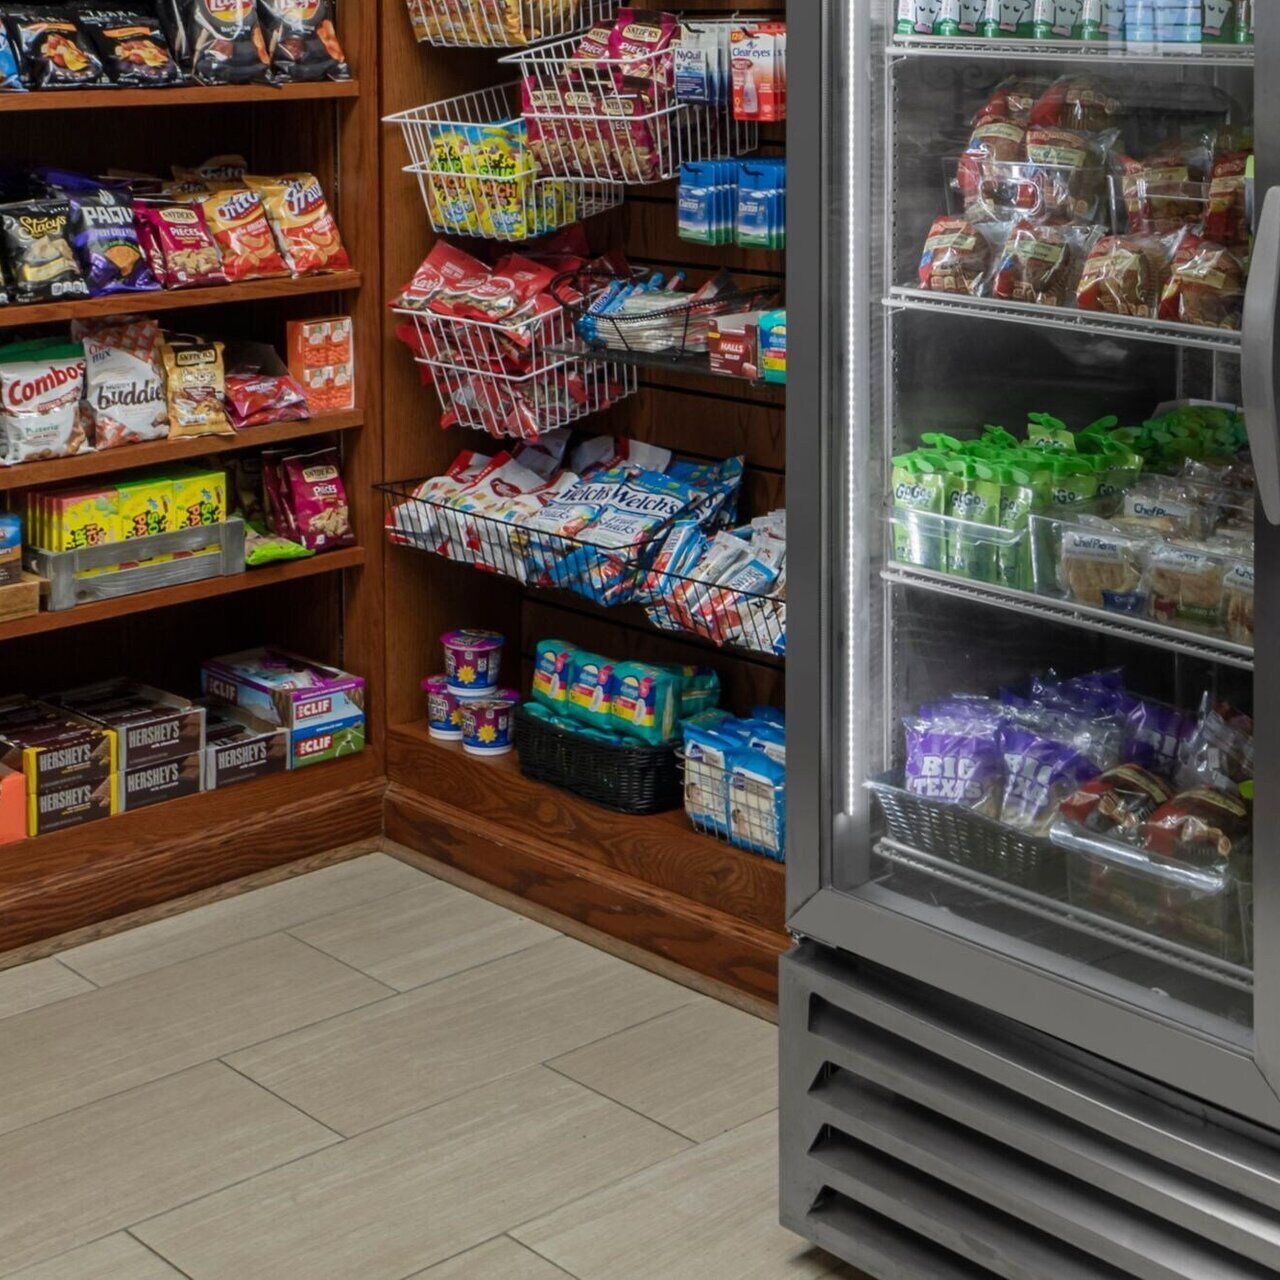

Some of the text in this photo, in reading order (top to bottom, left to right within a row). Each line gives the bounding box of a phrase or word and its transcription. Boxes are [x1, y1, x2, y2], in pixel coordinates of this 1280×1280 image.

[676, 50, 701, 60] NyQuil
[733, 48, 770, 58] Clear eyes
[721, 343, 744, 354] HALLS
[9, 362, 85, 406] Combos
[613, 488, 679, 515] Welch's
[302, 700, 330, 717] CLIF
[128, 720, 180, 749] HERSHEY'S
[305, 736, 332, 753] CLIF
[38, 744, 92, 772] HERSHEY'S
[218, 741, 267, 770] HERSHEY'S
[921, 757, 975, 778] BIG
[127, 763, 179, 793] HERSHEY'S
[38, 785, 92, 814] HERSHEY'S
